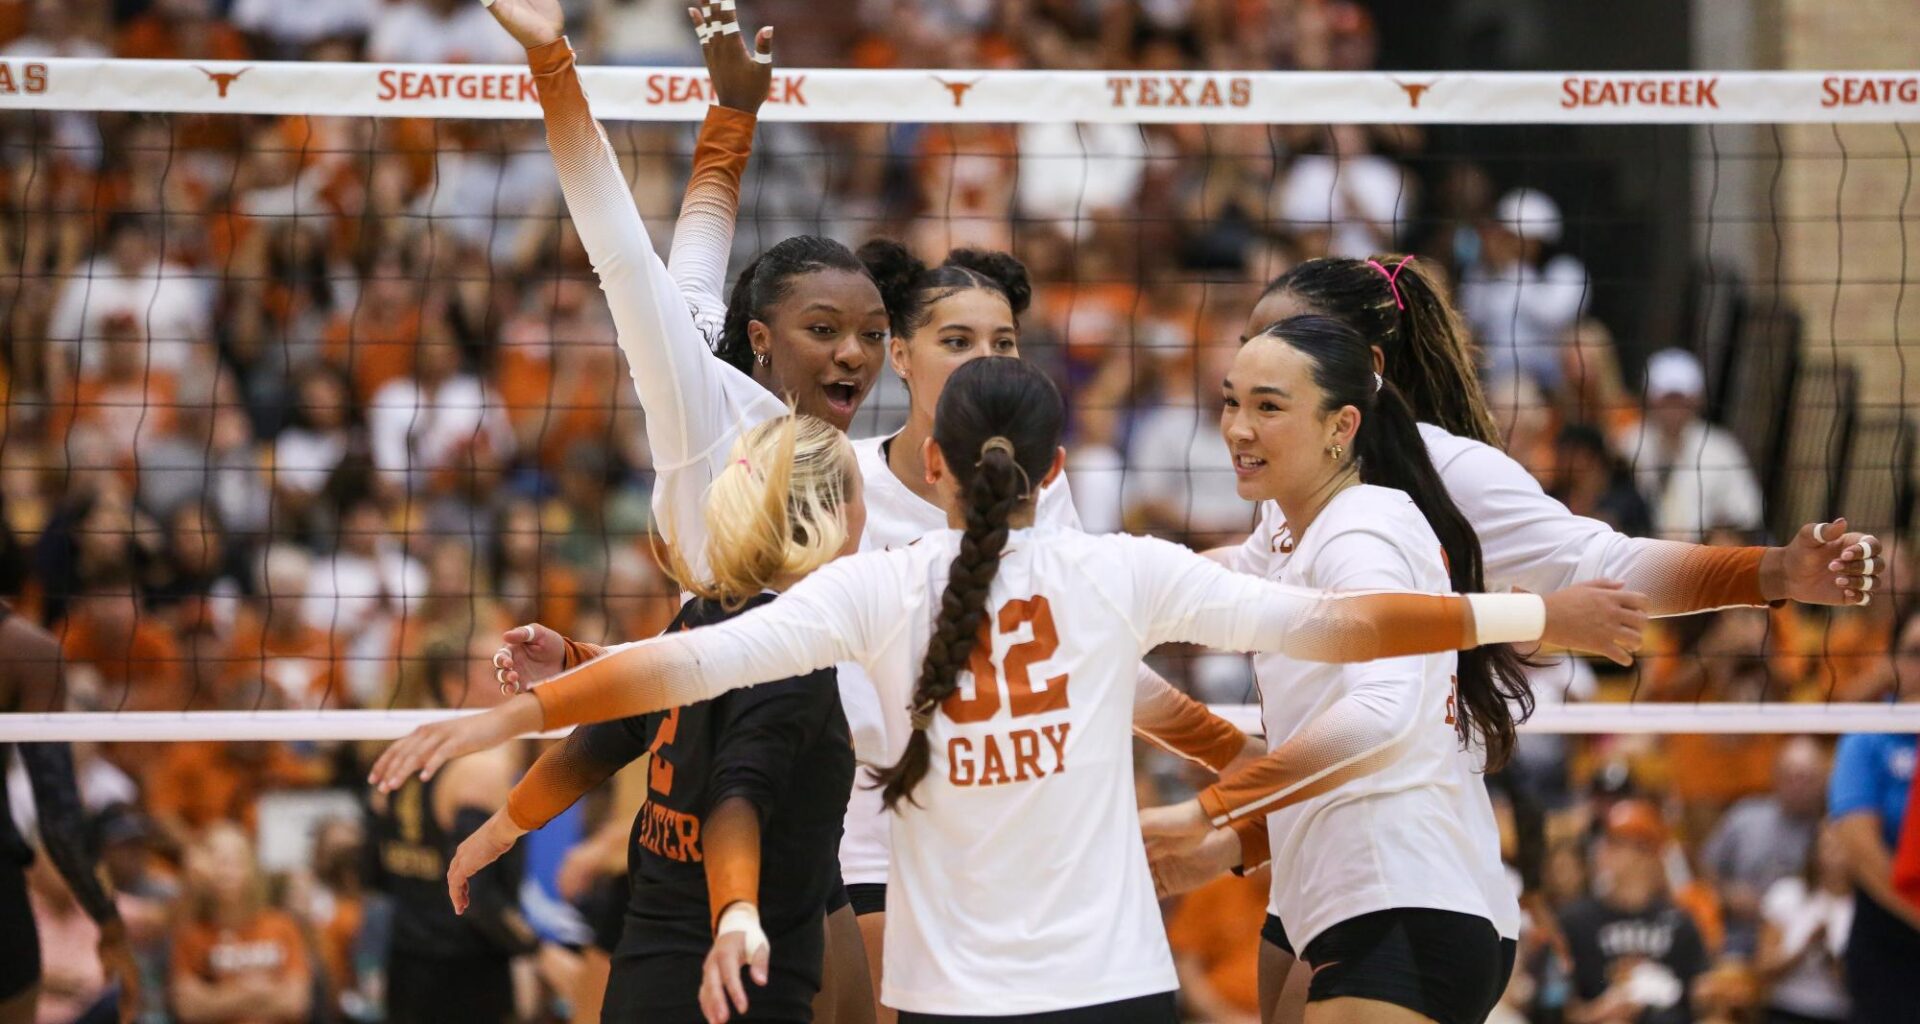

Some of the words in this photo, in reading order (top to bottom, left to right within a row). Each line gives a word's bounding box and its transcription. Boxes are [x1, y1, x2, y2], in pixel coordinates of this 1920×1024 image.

[377, 69, 539, 102] SEATGEEK
[646, 74, 807, 106] SEATEK
[1107, 77, 1253, 107] TEXAS
[1561, 77, 1719, 109] SEATGEEK
[948, 722, 1071, 786] GARY
